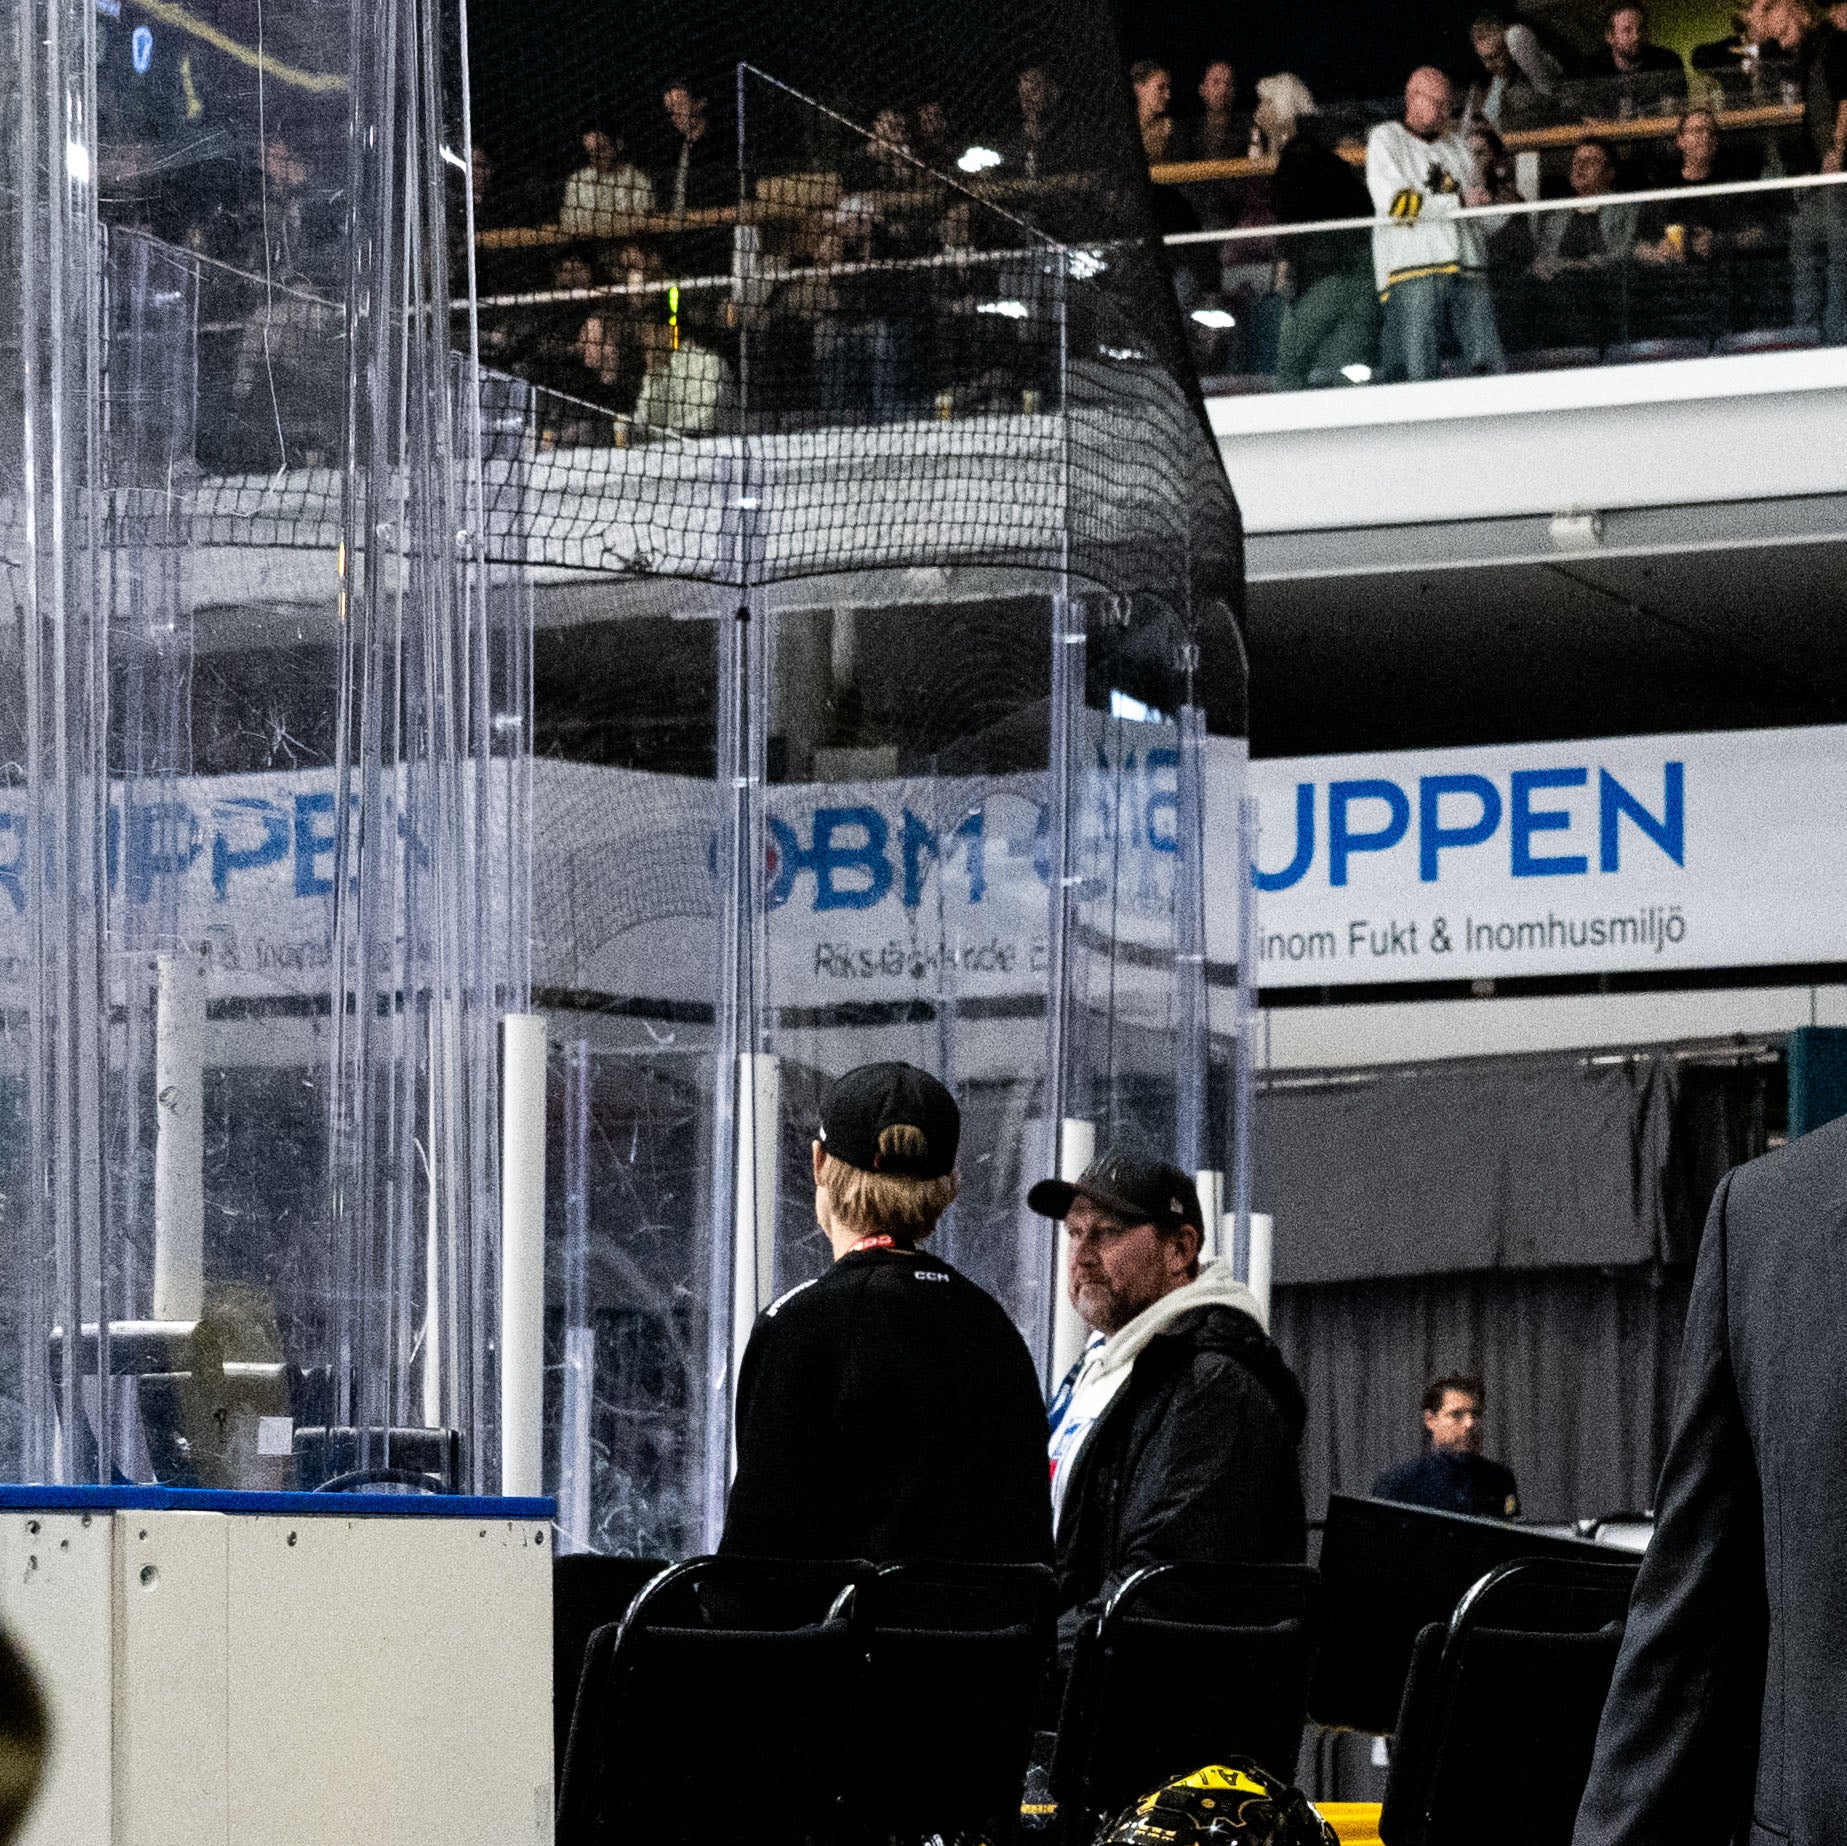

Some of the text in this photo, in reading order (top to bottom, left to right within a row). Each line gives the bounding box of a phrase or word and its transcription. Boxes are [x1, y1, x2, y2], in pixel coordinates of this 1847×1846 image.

[1259, 928, 1336, 962] inom
[1350, 920, 1418, 959] Fukt
[1430, 916, 1453, 954] &
[1466, 905, 1687, 954] Inomhusmiljö
